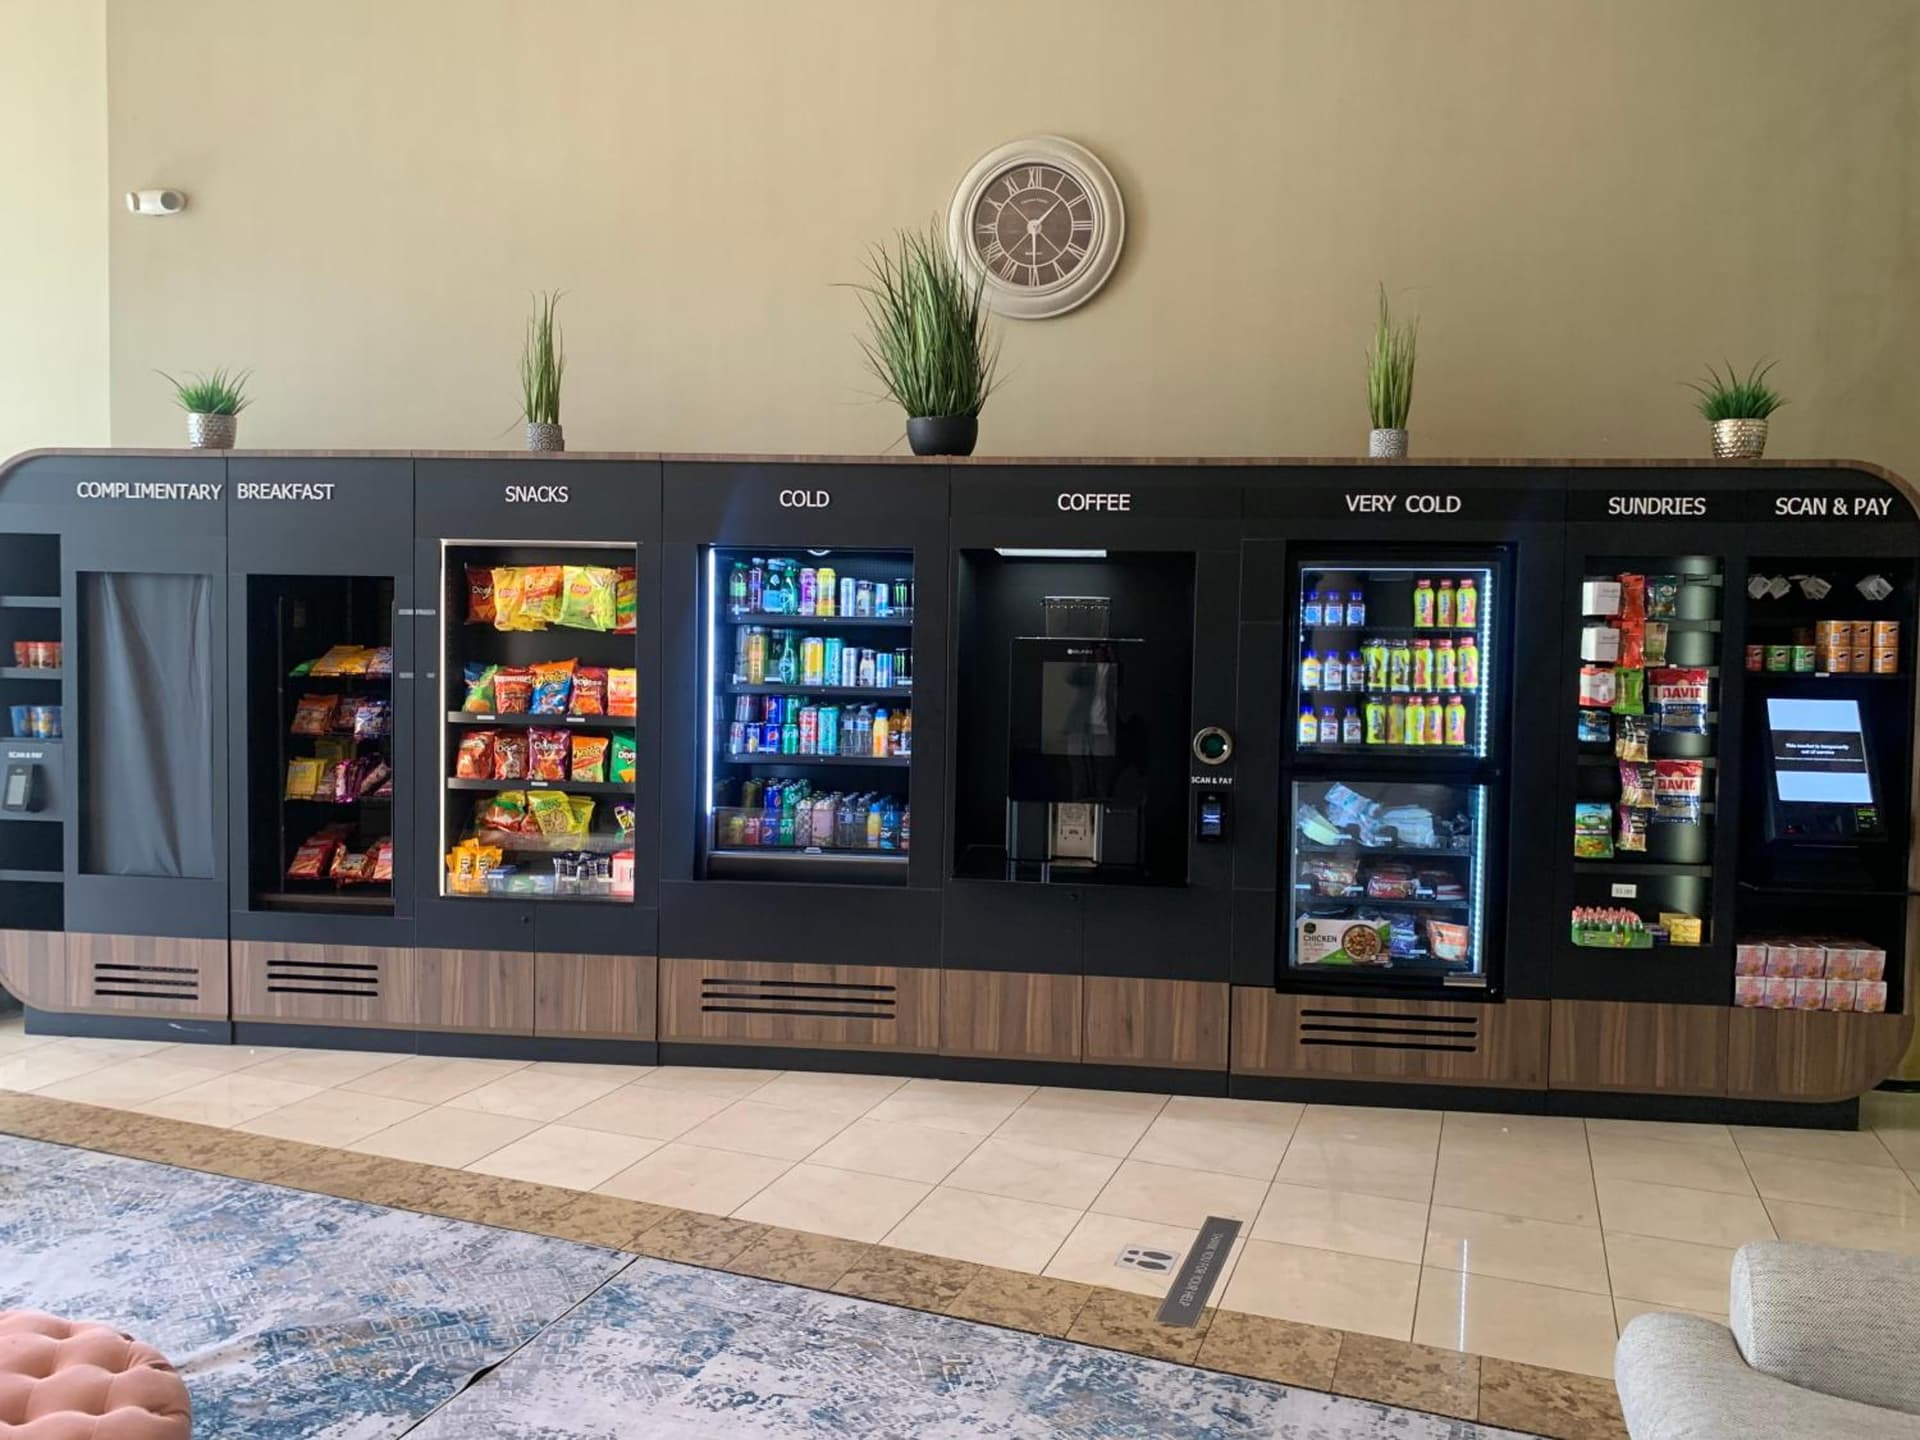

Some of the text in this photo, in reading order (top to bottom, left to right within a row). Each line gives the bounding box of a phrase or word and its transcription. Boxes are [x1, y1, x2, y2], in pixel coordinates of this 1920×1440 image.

[77, 482, 335, 500] COMPLIMENTARY BREAKFAST
[505, 486, 568, 503] SNACKS
[779, 490, 829, 507] COLD
[1058, 493, 1131, 511] COFFEE
[1345, 494, 1461, 513] VERY COLD
[1609, 497, 1706, 515] SUNDRIES
[1775, 497, 1892, 515] SCAN & PAY
[1191, 776, 1211, 784] SCAN
[1303, 935, 1337, 943] CHICKEN
